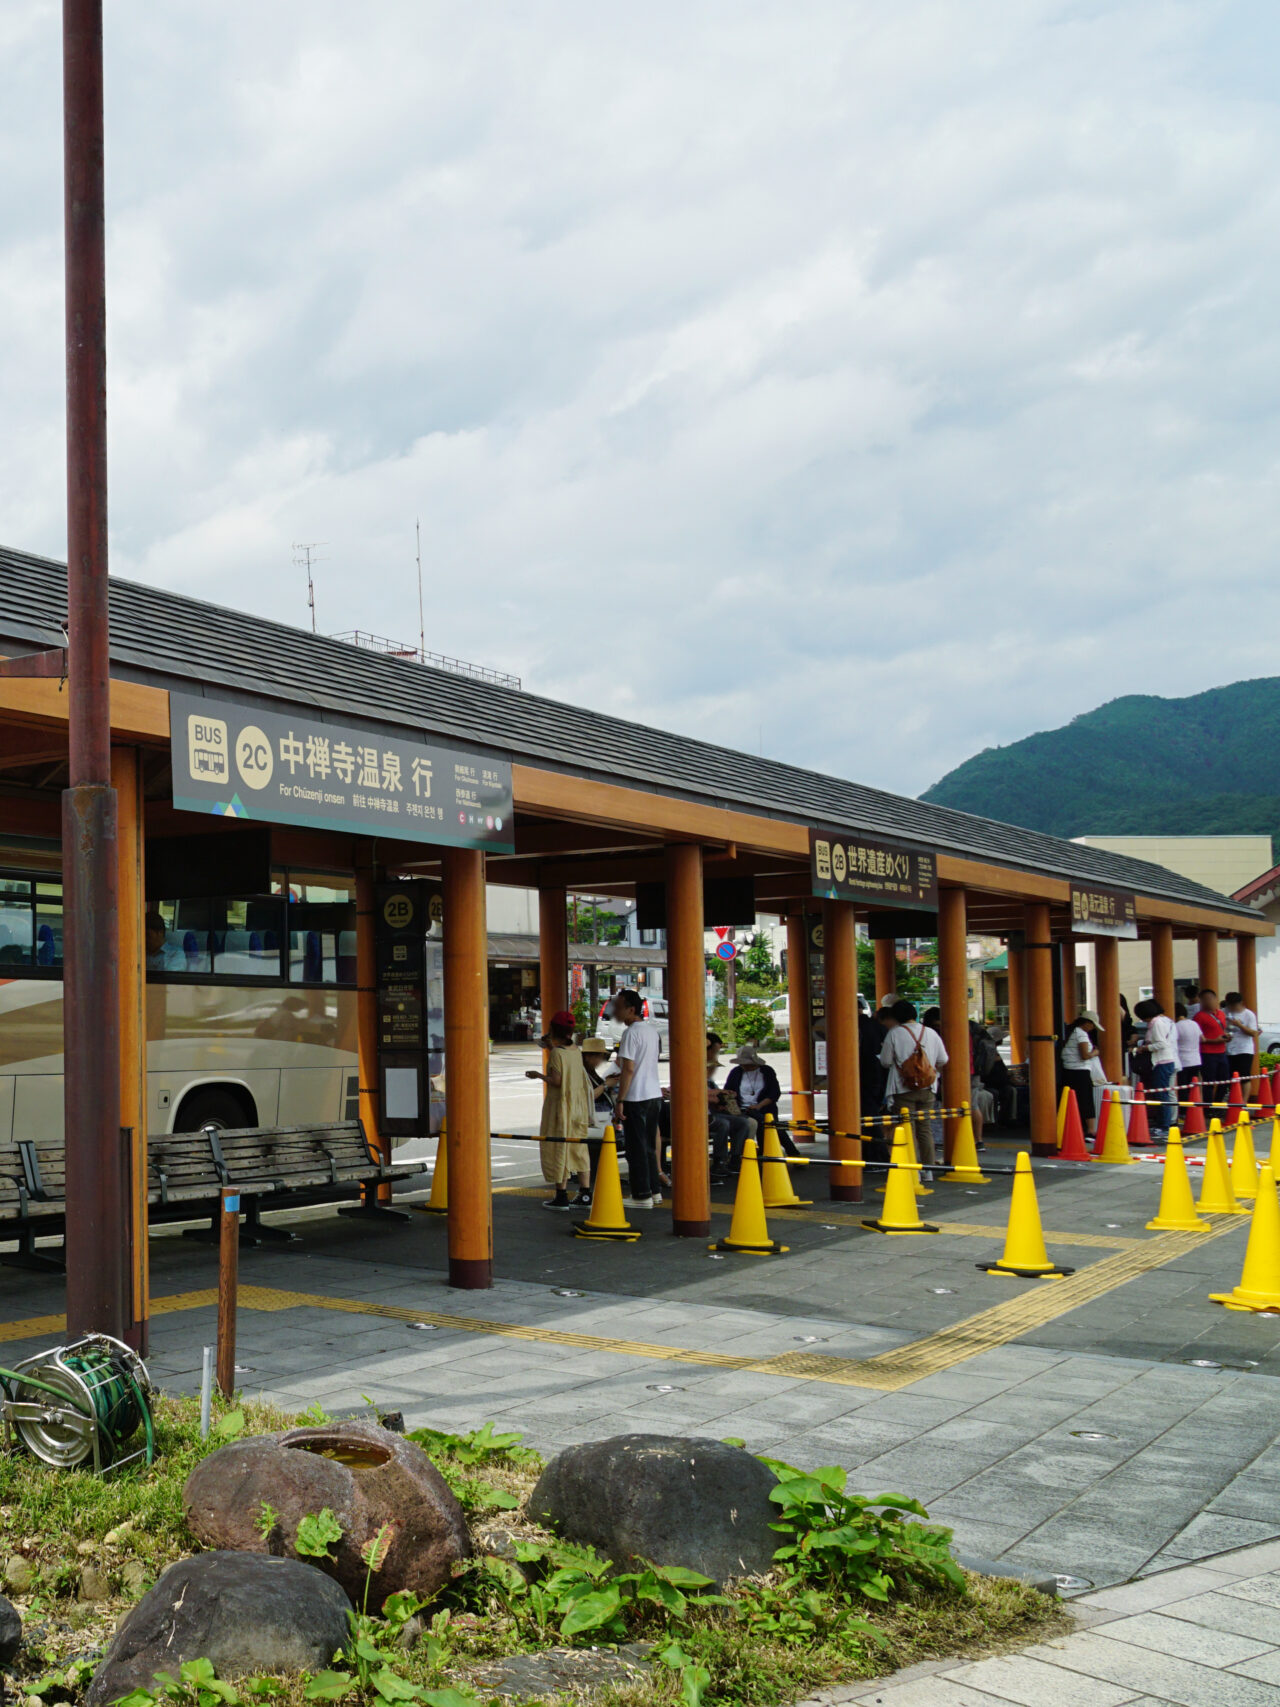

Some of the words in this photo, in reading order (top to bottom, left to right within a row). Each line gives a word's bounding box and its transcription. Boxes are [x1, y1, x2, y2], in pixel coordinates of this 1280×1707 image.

[194, 724, 222, 745] BUS
[242, 743, 268, 771] 2C
[279, 730, 404, 793] 中禅寺温泉
[411, 757, 433, 798] 行
[279, 783, 292, 796] For
[324, 792, 345, 805] onsen
[835, 854, 844, 870] 2B
[847, 845, 910, 879] 世界遺産めぐり
[388, 902, 409, 917] 2B
